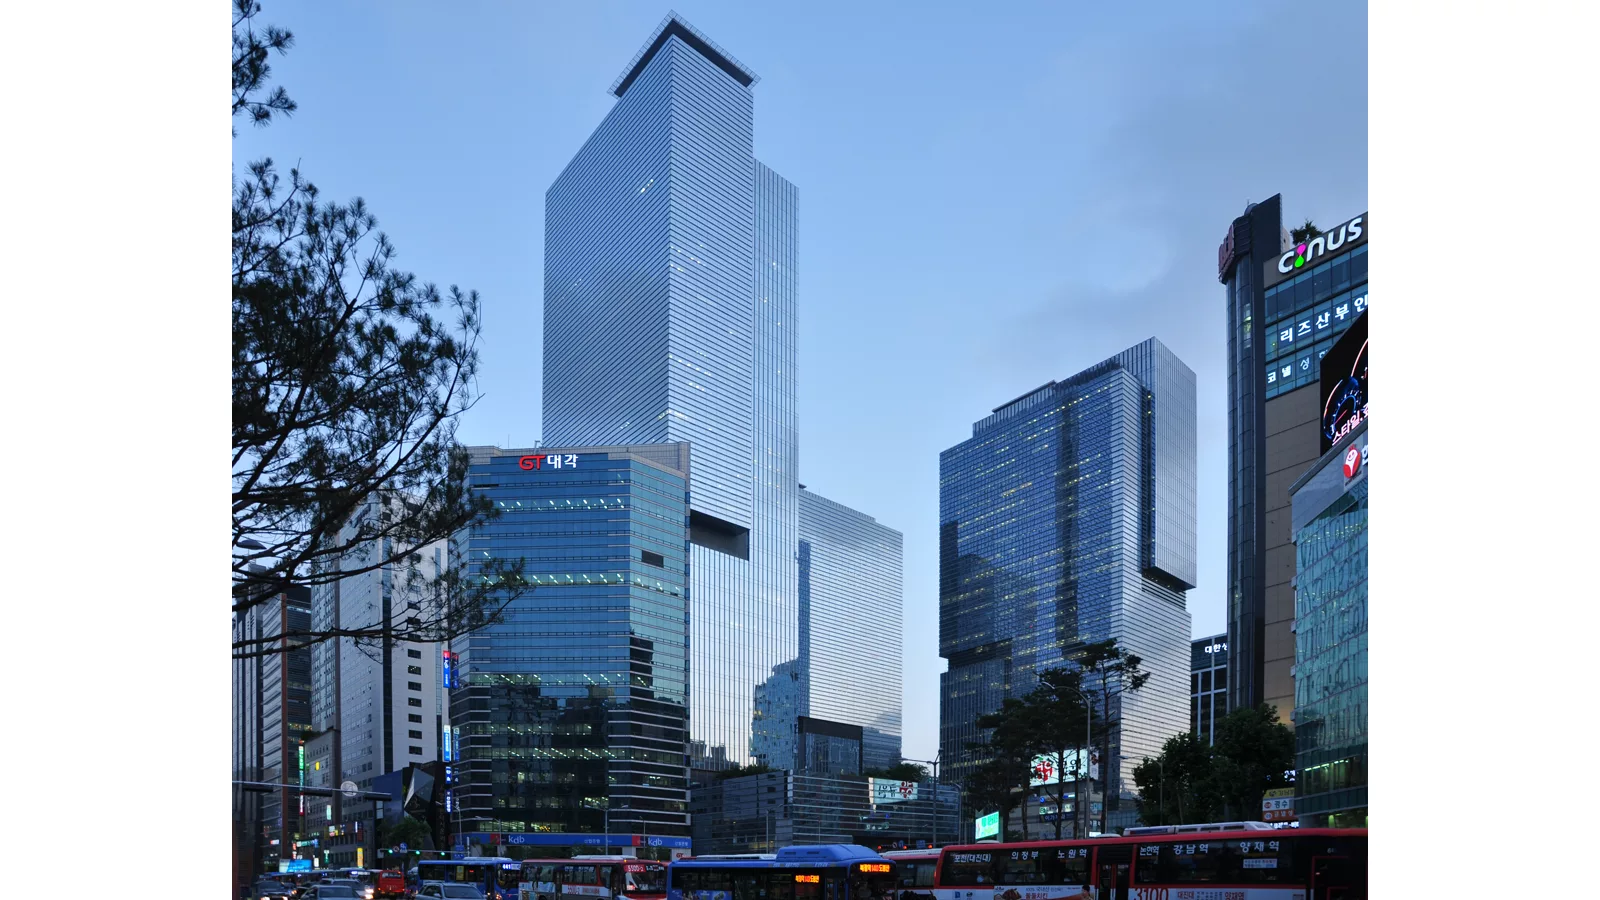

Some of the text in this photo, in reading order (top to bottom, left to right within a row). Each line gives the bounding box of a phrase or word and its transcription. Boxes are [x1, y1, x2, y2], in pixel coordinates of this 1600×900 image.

[508, 835, 525, 844] kdb
[648, 837, 663, 846] kdb
[1139, 845, 1160, 856] 논현역
[1173, 843, 1209, 855] 강남역
[1239, 840, 1280, 853] 양재역
[953, 853, 992, 863] 포천(대진대)
[1011, 851, 1039, 860] 의정부
[1057, 848, 1087, 859] 노원역
[627, 864, 644, 872] 5500-2
[1134, 888, 1169, 900] 3100
